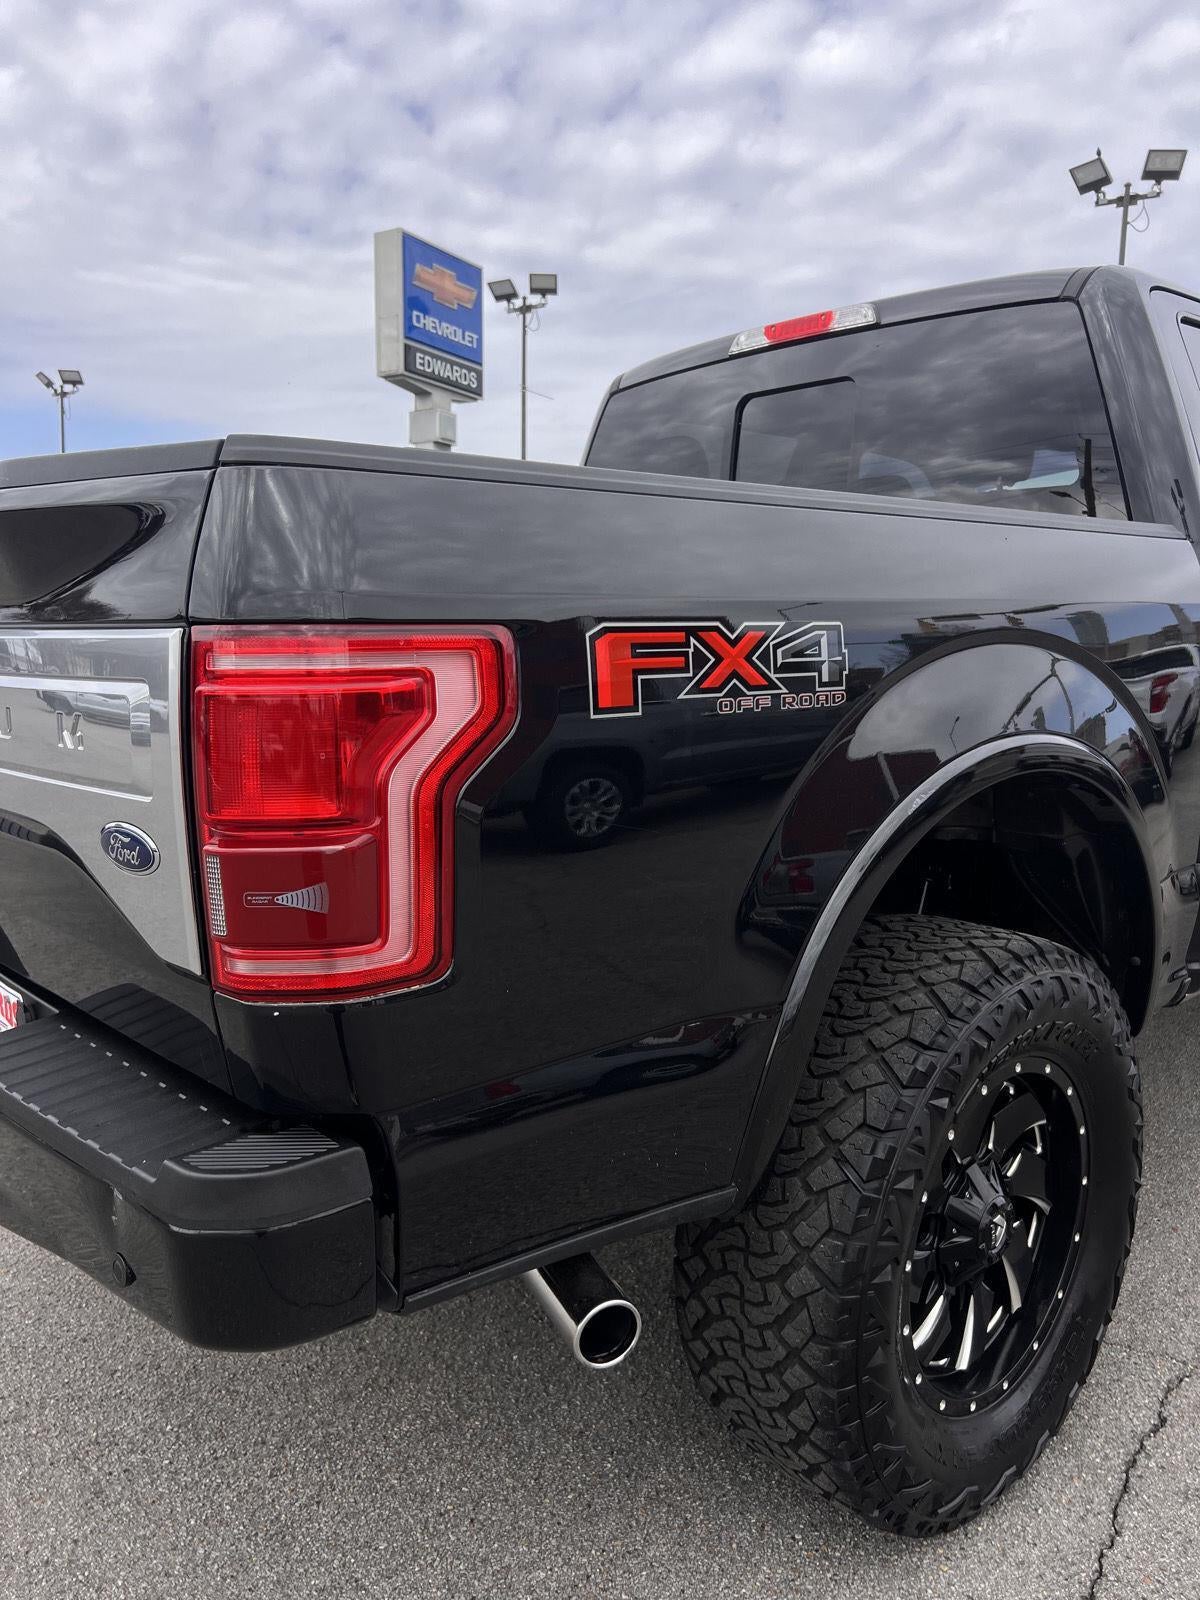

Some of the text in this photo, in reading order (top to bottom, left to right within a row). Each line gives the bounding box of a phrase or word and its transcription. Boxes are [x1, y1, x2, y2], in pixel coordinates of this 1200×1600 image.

[412, 311, 479, 348] CHEVROLET
[415, 352, 478, 388] EDWARDS
[586, 621, 848, 719] FX4
[717, 691, 848, 715] OFF ROAD
[108, 832, 141, 866] Ford
